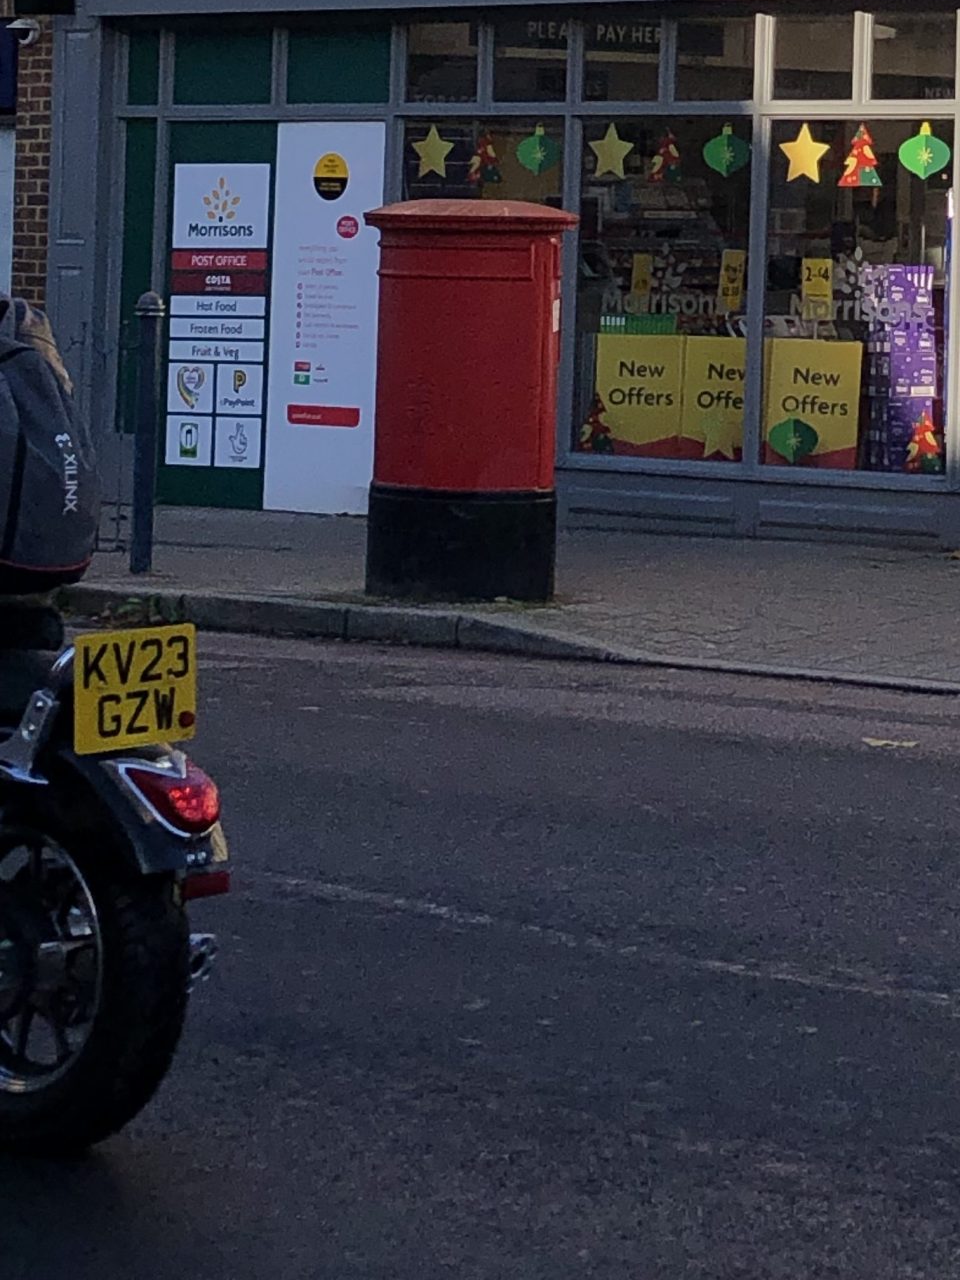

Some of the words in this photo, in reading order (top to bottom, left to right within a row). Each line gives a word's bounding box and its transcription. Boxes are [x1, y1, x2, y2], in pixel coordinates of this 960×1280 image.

[528, 21, 569, 40] PLEA
[596, 24, 625, 43] PAY
[632, 26, 662, 44] HER
[188, 217, 254, 237] Morrisons
[191, 256, 214, 266] POST
[215, 255, 247, 266] OFFICE
[205, 275, 231, 285] COSTA
[196, 301, 213, 311] Hot
[215, 301, 237, 312] Food
[190, 323, 219, 334] Frozen
[221, 324, 243, 334] Food
[192, 345, 211, 356] Fruit
[214, 346, 221, 354] &
[223, 347, 240, 360] Veg
[619, 361, 665, 378] New
[793, 367, 840, 386] New
[608, 387, 674, 407] Offers
[697, 390, 745, 410] Offe
[782, 395, 848, 417] Offers
[63, 453, 78, 512] XILINX
[83, 635, 189, 689] KV23
[97, 687, 175, 738] GZW
